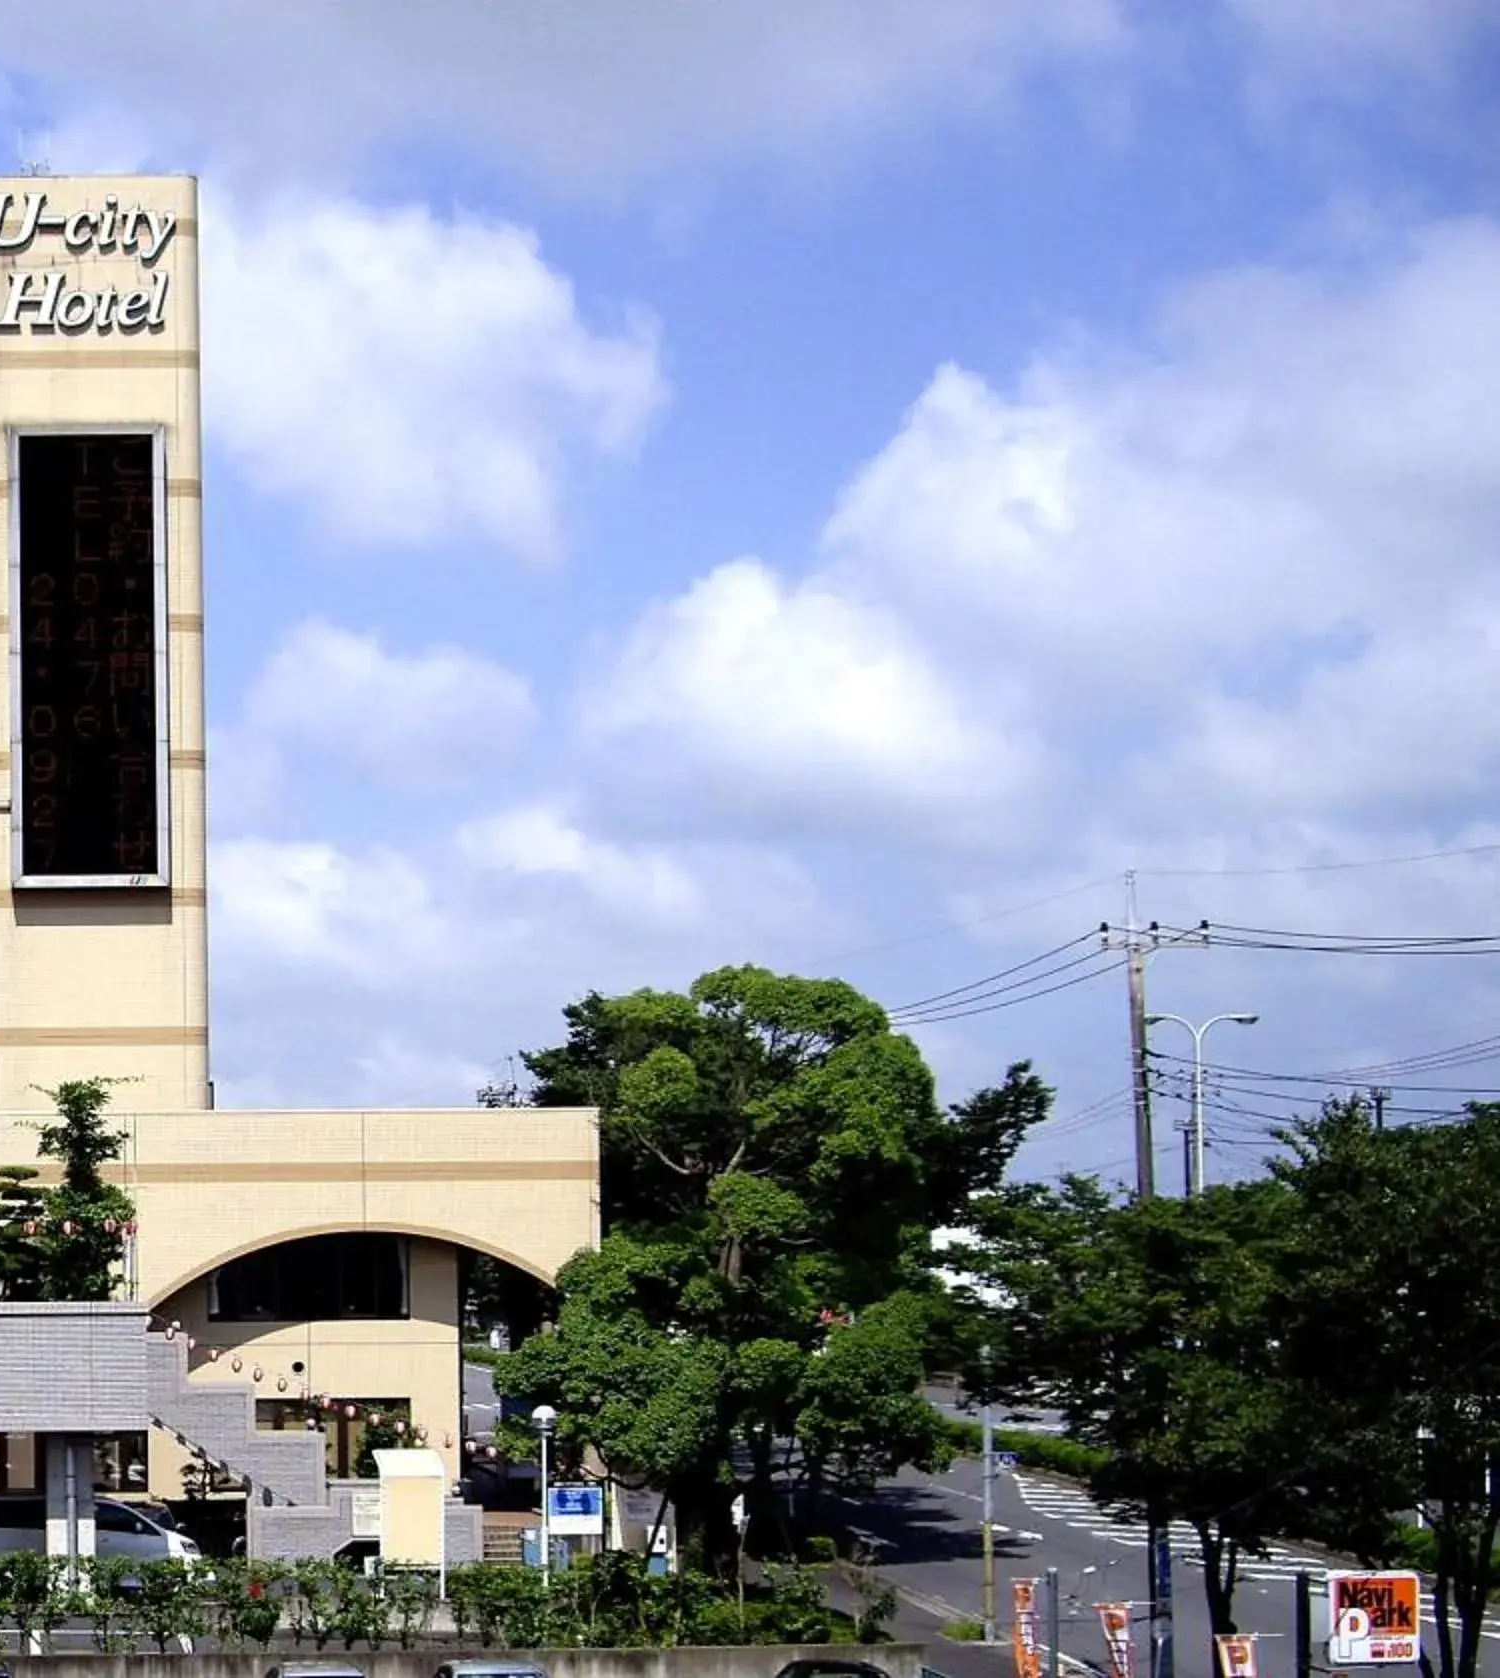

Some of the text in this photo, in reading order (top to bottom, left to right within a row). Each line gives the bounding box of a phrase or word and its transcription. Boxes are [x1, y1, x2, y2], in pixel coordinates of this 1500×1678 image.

[1338, 1580, 1393, 1608] Navi
[1337, 1598, 1413, 1658] Park
[1227, 1645, 1249, 1675] P
